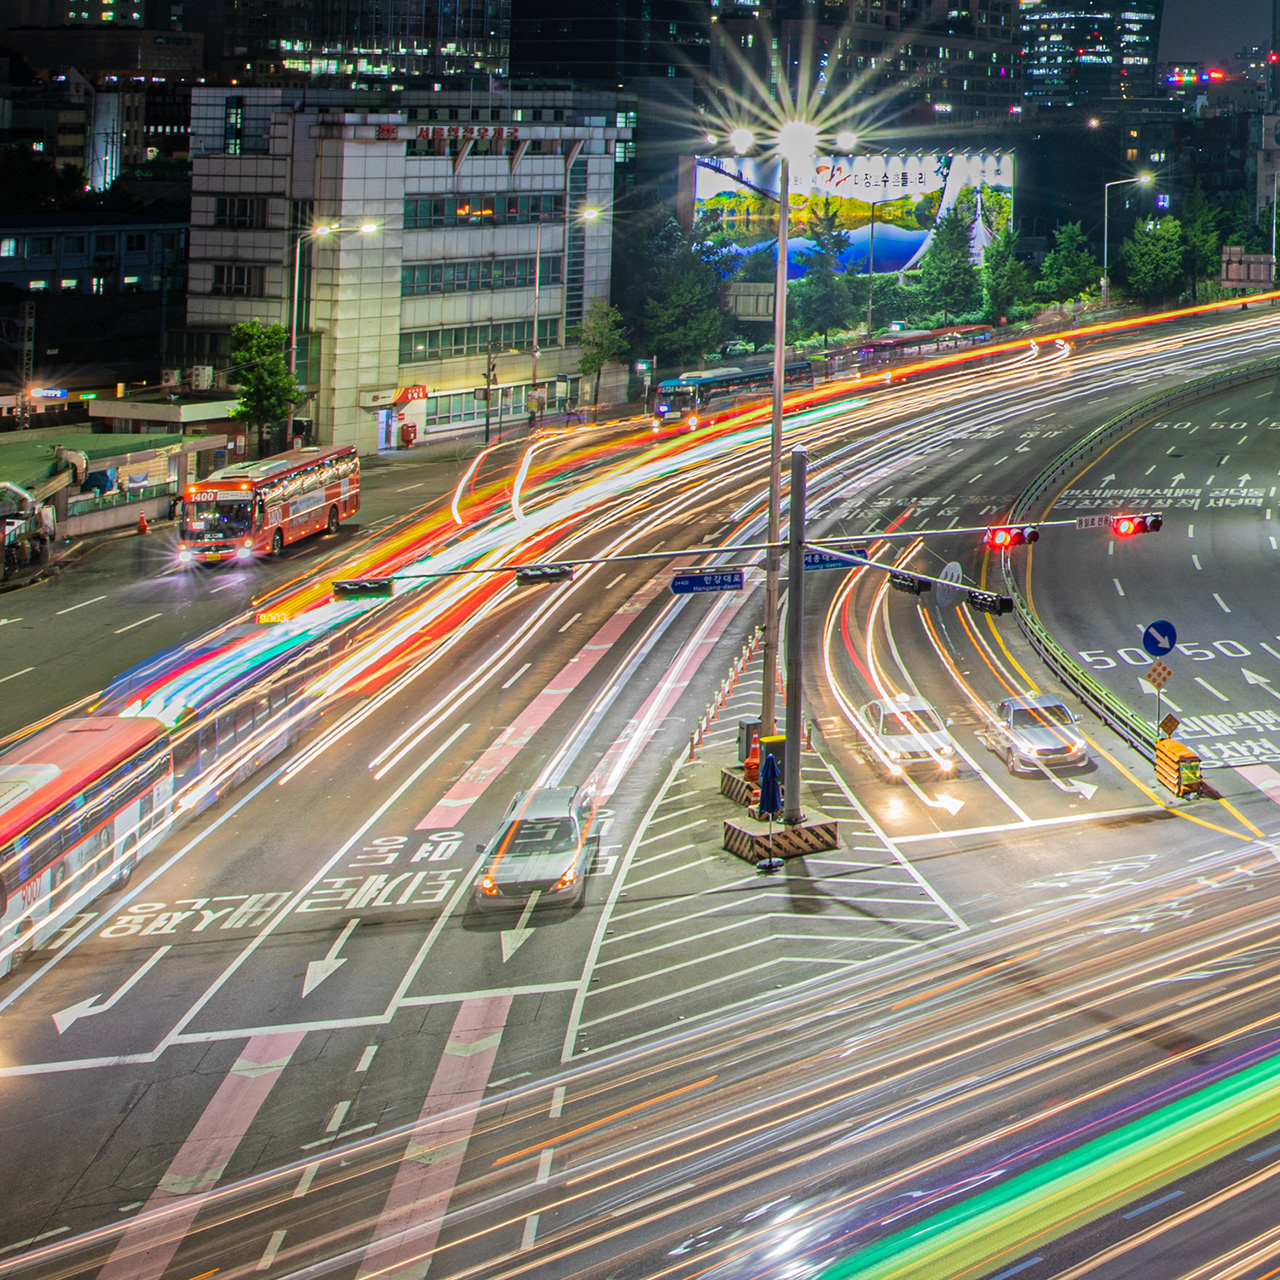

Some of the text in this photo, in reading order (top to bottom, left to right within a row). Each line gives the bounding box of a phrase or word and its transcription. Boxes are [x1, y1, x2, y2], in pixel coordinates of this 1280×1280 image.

[1151, 421, 1192, 431] 50
[1209, 421, 1249, 431] 50
[190, 492, 214, 502] 1400
[1208, 488, 1266, 497] 공덕동
[1053, 499, 1124, 509] 경찰청
[1128, 498, 1196, 509] 경찰청
[1205, 497, 1263, 508] 서부역
[703, 574, 742, 585] 한강대로
[692, 583, 741, 592] Hangang-daero
[1180, 639, 1252, 661] 50
[1080, 646, 1152, 670] 50
[295, 868, 465, 912] 퇴계로
[99, 891, 293, 938] 버스전용
